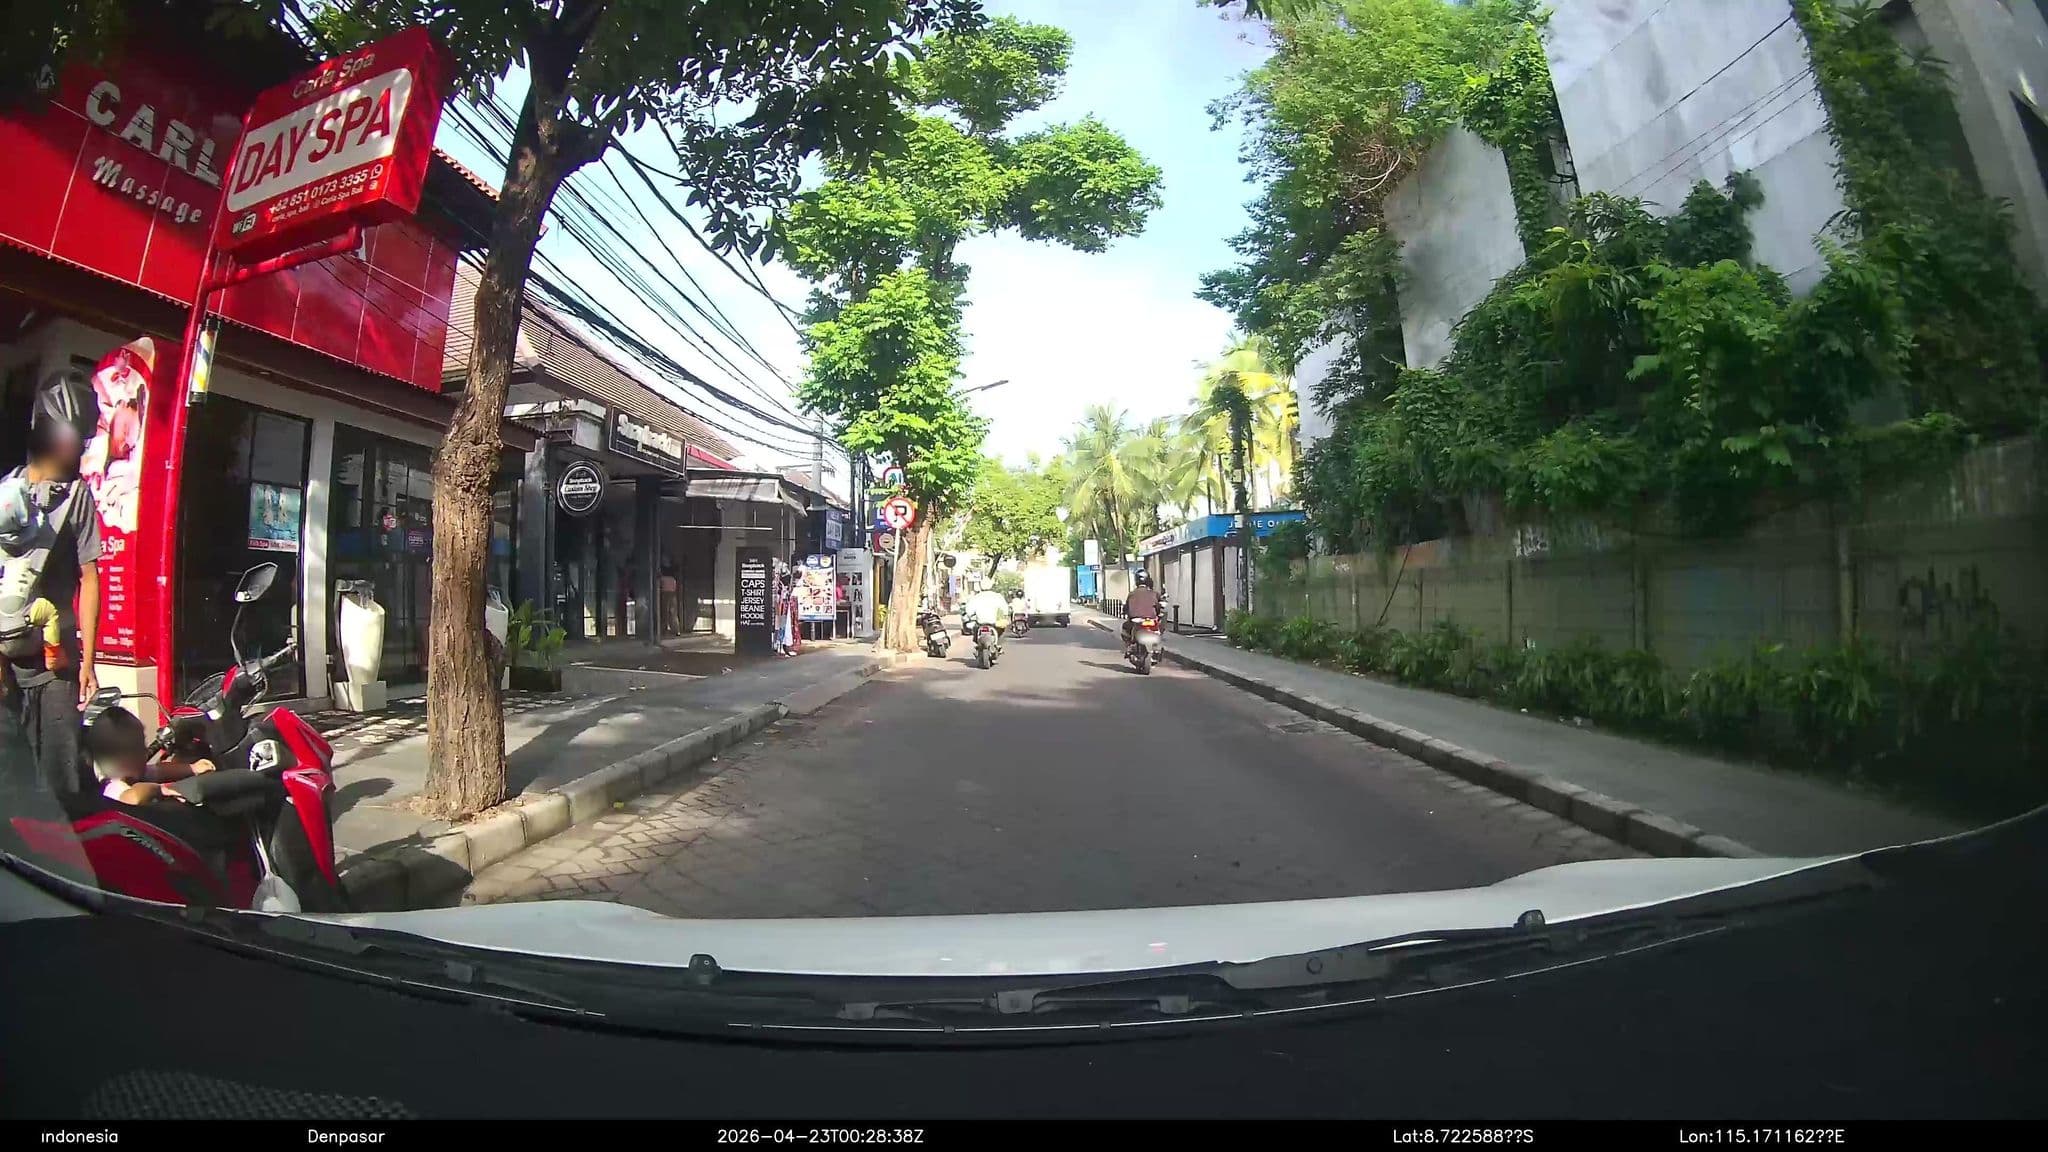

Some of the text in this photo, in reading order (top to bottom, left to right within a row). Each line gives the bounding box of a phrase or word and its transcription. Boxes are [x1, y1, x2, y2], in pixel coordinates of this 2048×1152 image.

[341, 54, 375, 78] Spa
[233, 87, 391, 195] DAY SPA
[92, 156, 202, 223] Massage
[290, 189, 309, 206] 851
[311, 180, 338, 199] 0173
[339, 169, 368, 189] 3355
[108, 536, 125, 556] Spa
[741, 579, 765, 588] CAPS
[741, 588, 765, 596] T-SHIRT
[740, 596, 765, 604] JERSEY
[740, 604, 765, 612] BEANIE
[740, 612, 765, 620] HOODIE
